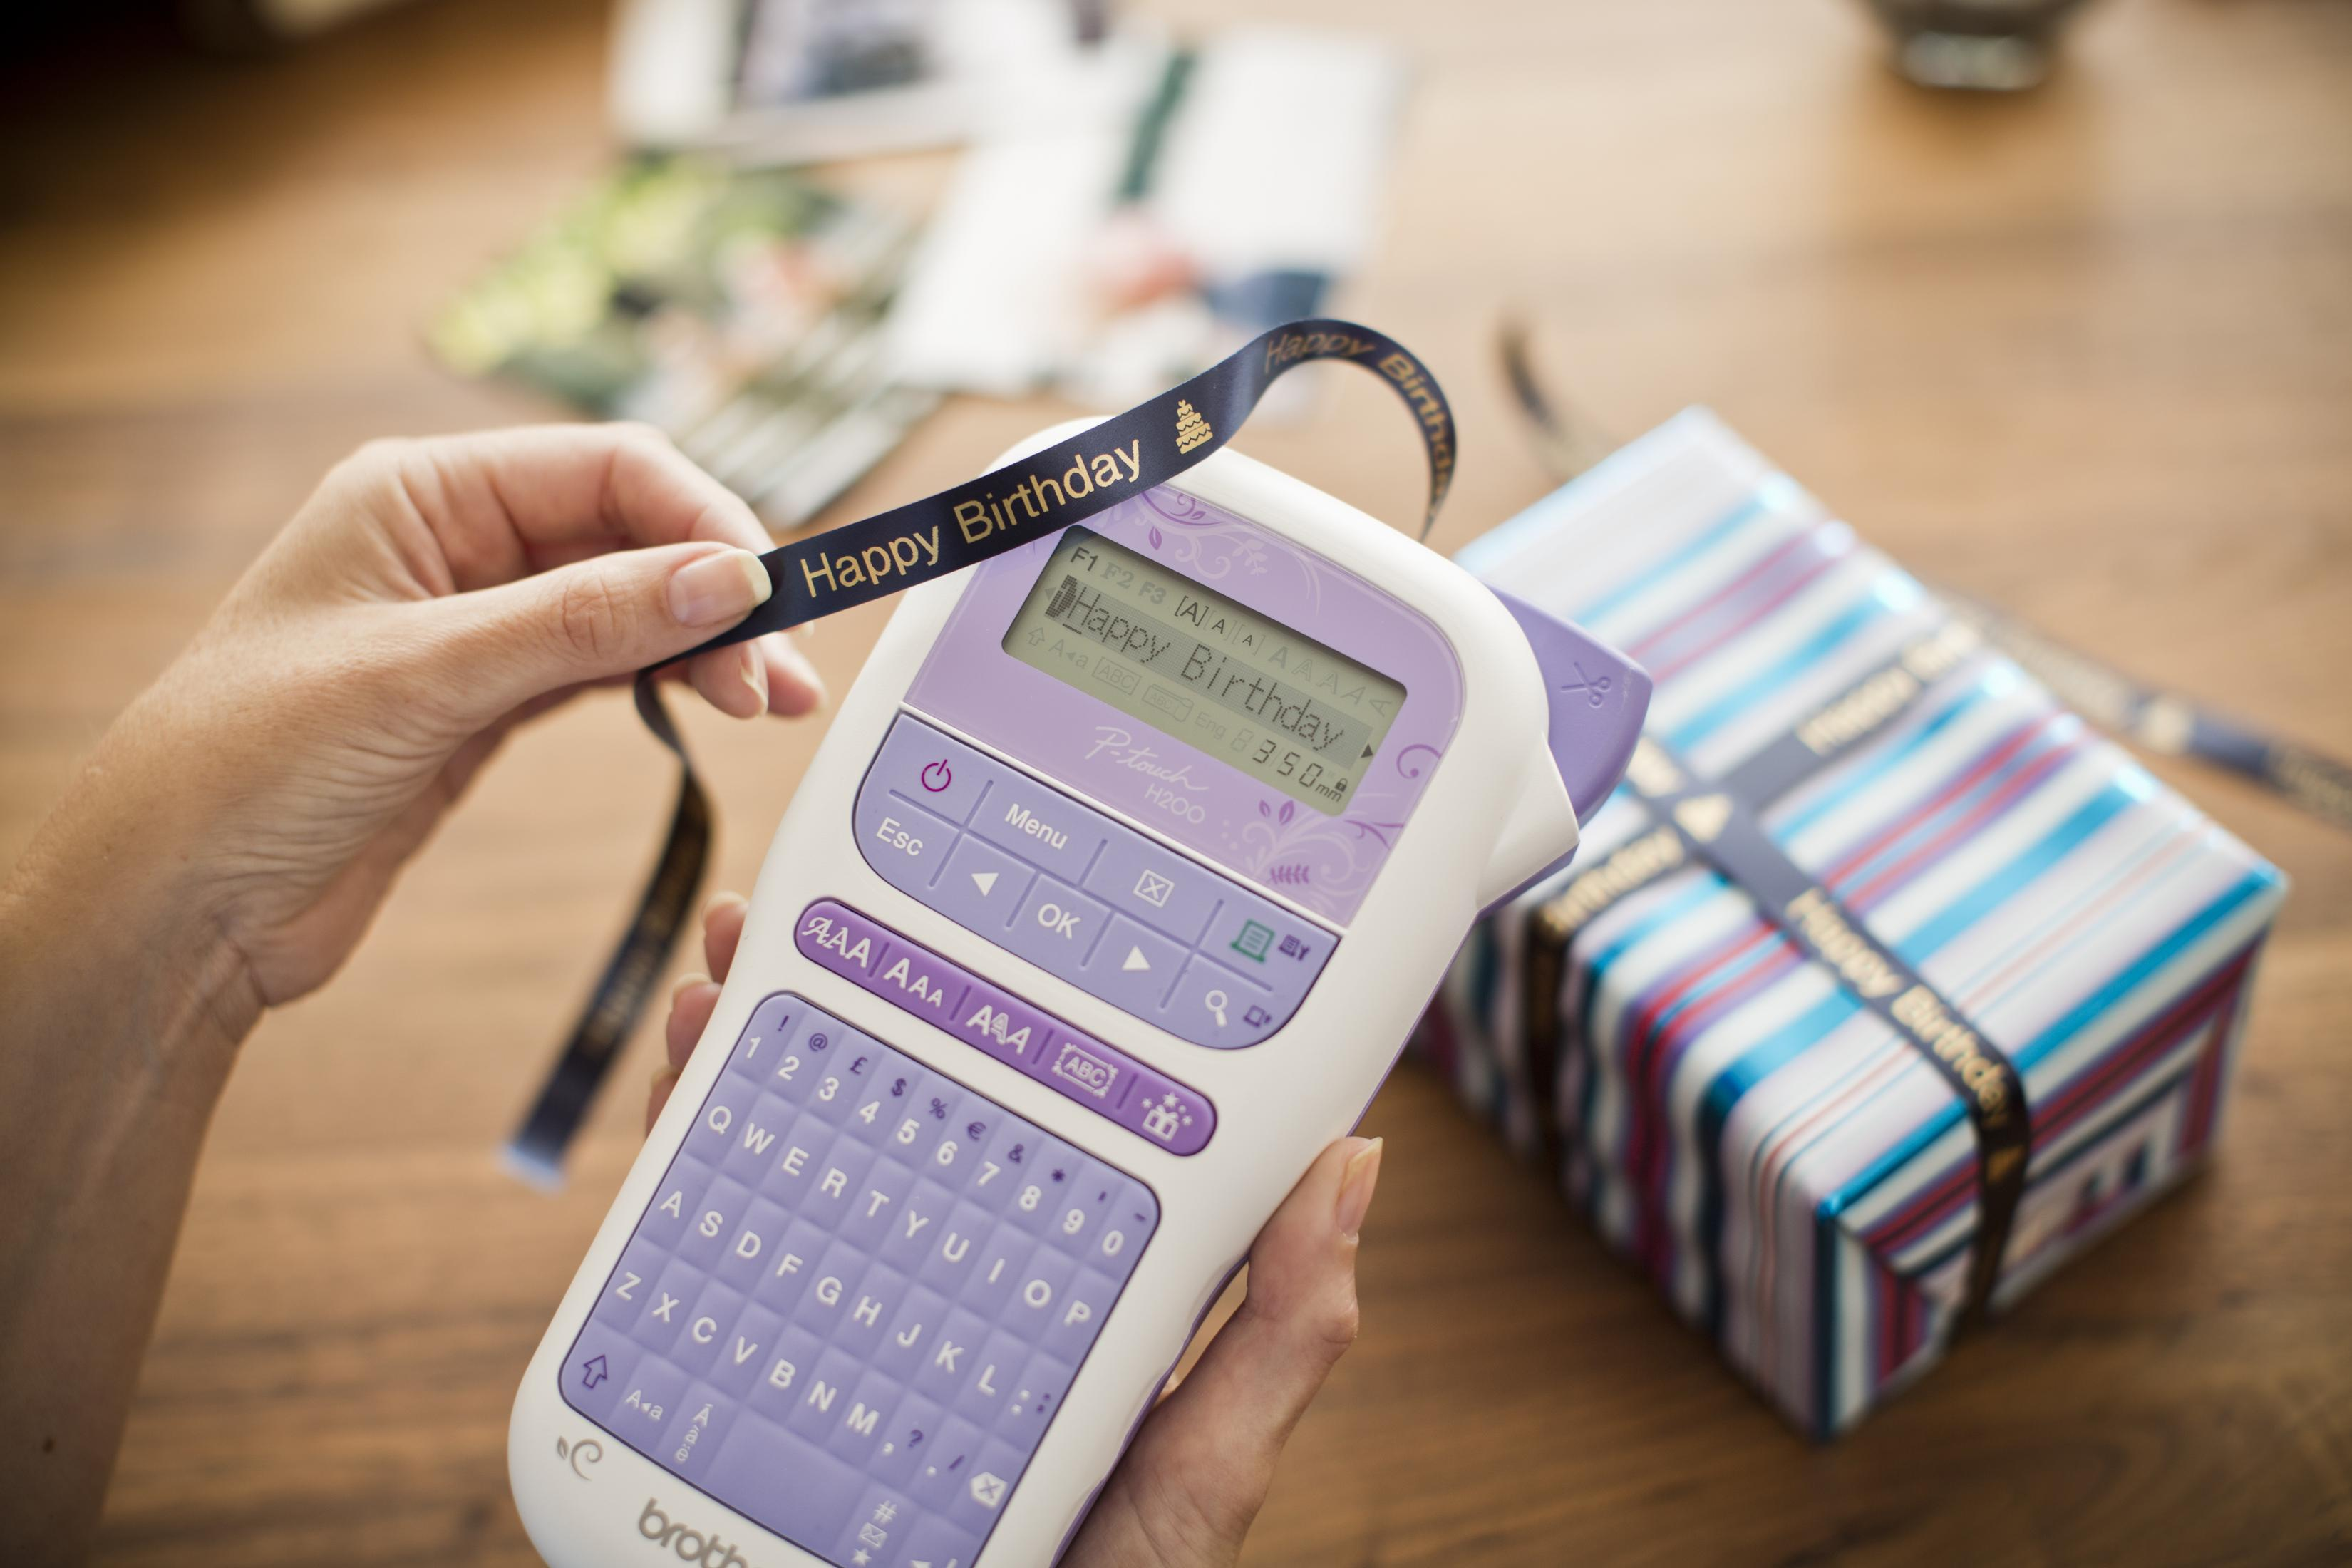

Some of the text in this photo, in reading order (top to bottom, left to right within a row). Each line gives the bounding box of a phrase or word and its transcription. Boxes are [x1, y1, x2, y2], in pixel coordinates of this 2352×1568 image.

[1266, 333, 1376, 374] Happy
[800, 439, 1140, 598] Happy Birthday
[1069, 547, 1099, 572] F1
[1100, 562, 1135, 589] F2
[1138, 581, 1167, 605] F3
[1067, 587, 1344, 751] Happy Birthday
[1098, 663, 1135, 690] ABC
[1194, 711, 1227, 741] Eng
[1085, 726, 1209, 790] P-touch
[1004, 803, 1068, 850] Menu
[1144, 783, 1205, 824] H200
[876, 817, 924, 857] Esc
[1037, 902, 1081, 940] OK
[1064, 1055, 1107, 1088] ABC
[746, 1036, 1125, 1256] 1 2 3 4 5 6 7 8 9 0
[708, 1105, 1092, 1326] Q W E R T Y U I O P
[659, 1190, 684, 1218] A
[698, 1210, 723, 1238] S
[735, 1229, 762, 1259] D
[775, 1252, 803, 1279] F
[815, 1276, 842, 1306] G
[852, 1295, 882, 1327] H
[896, 1324, 922, 1348] J
[934, 1340, 964, 1373] K
[977, 1364, 996, 1396] L
[615, 1271, 642, 1301] Z
[651, 1291, 680, 1323] X
[691, 1316, 717, 1344] C
[733, 1336, 758, 1365] V
[768, 1358, 796, 1389] B
[807, 1380, 837, 1413] N
[846, 1402, 880, 1436] M
[638, 1496, 760, 1568] broth
[872, 1500, 897, 1524] #
